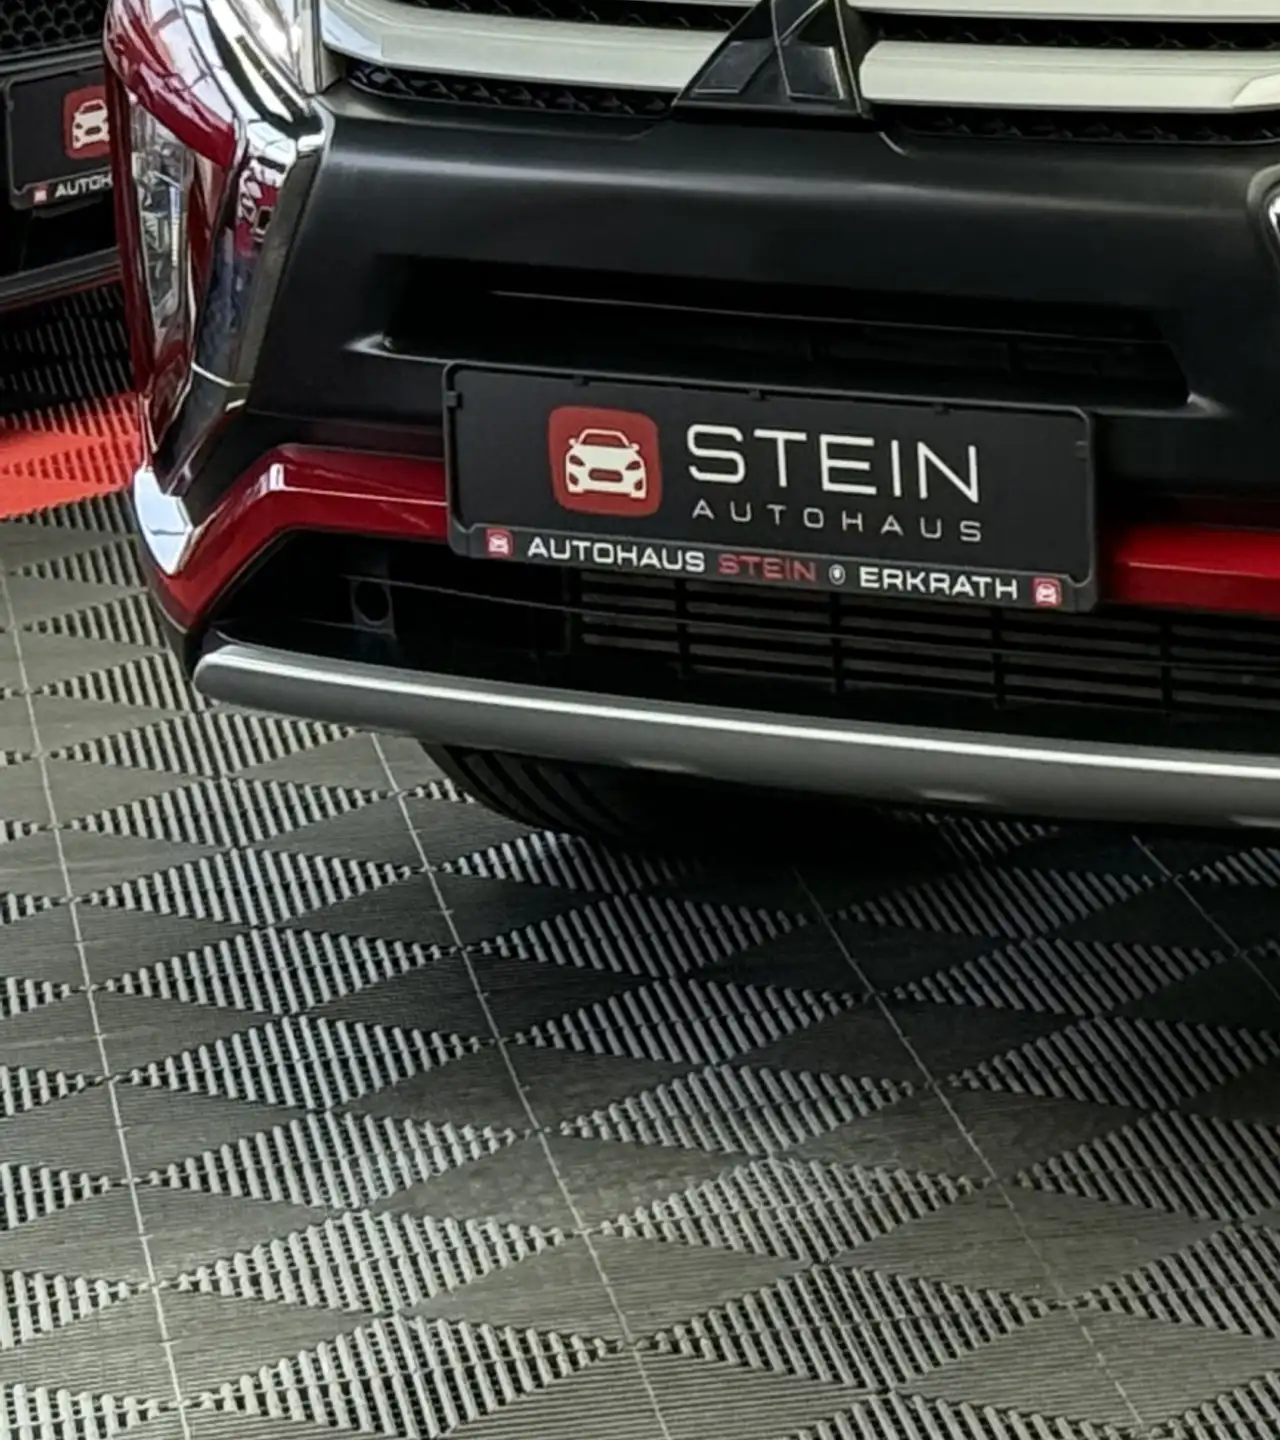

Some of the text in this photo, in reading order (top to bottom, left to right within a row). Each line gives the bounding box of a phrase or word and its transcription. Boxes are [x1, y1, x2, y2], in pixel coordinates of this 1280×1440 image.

[686, 424, 980, 503] STEIN
[692, 499, 983, 543] AUTOHAUS
[527, 536, 1018, 601] AUTOHAUS STEIN ERKRATH
